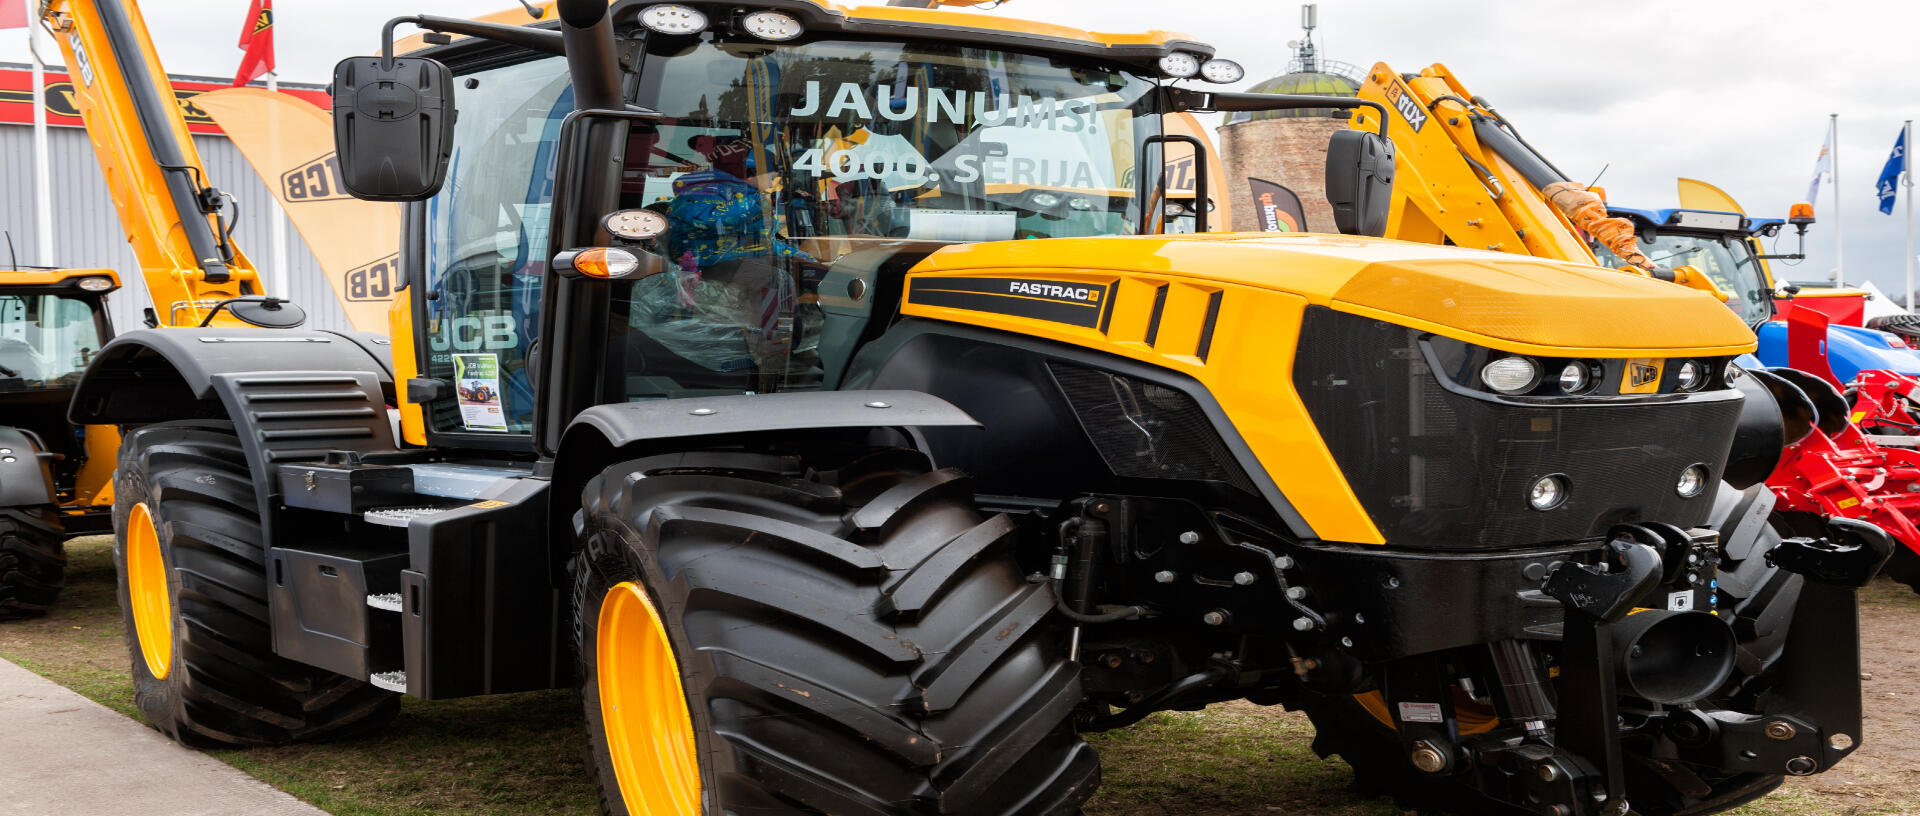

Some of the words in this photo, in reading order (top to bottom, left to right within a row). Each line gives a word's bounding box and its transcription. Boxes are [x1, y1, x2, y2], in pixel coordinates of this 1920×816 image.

[70, 34, 93, 87] JCB
[791, 81, 1097, 135] JAUNUMS!
[792, 149, 940, 182] 4000.
[953, 150, 1095, 189] SĒRIJA
[1009, 282, 1088, 300] FASTRAC
[430, 315, 518, 351] JCB
[1634, 365, 1657, 384] JCB
